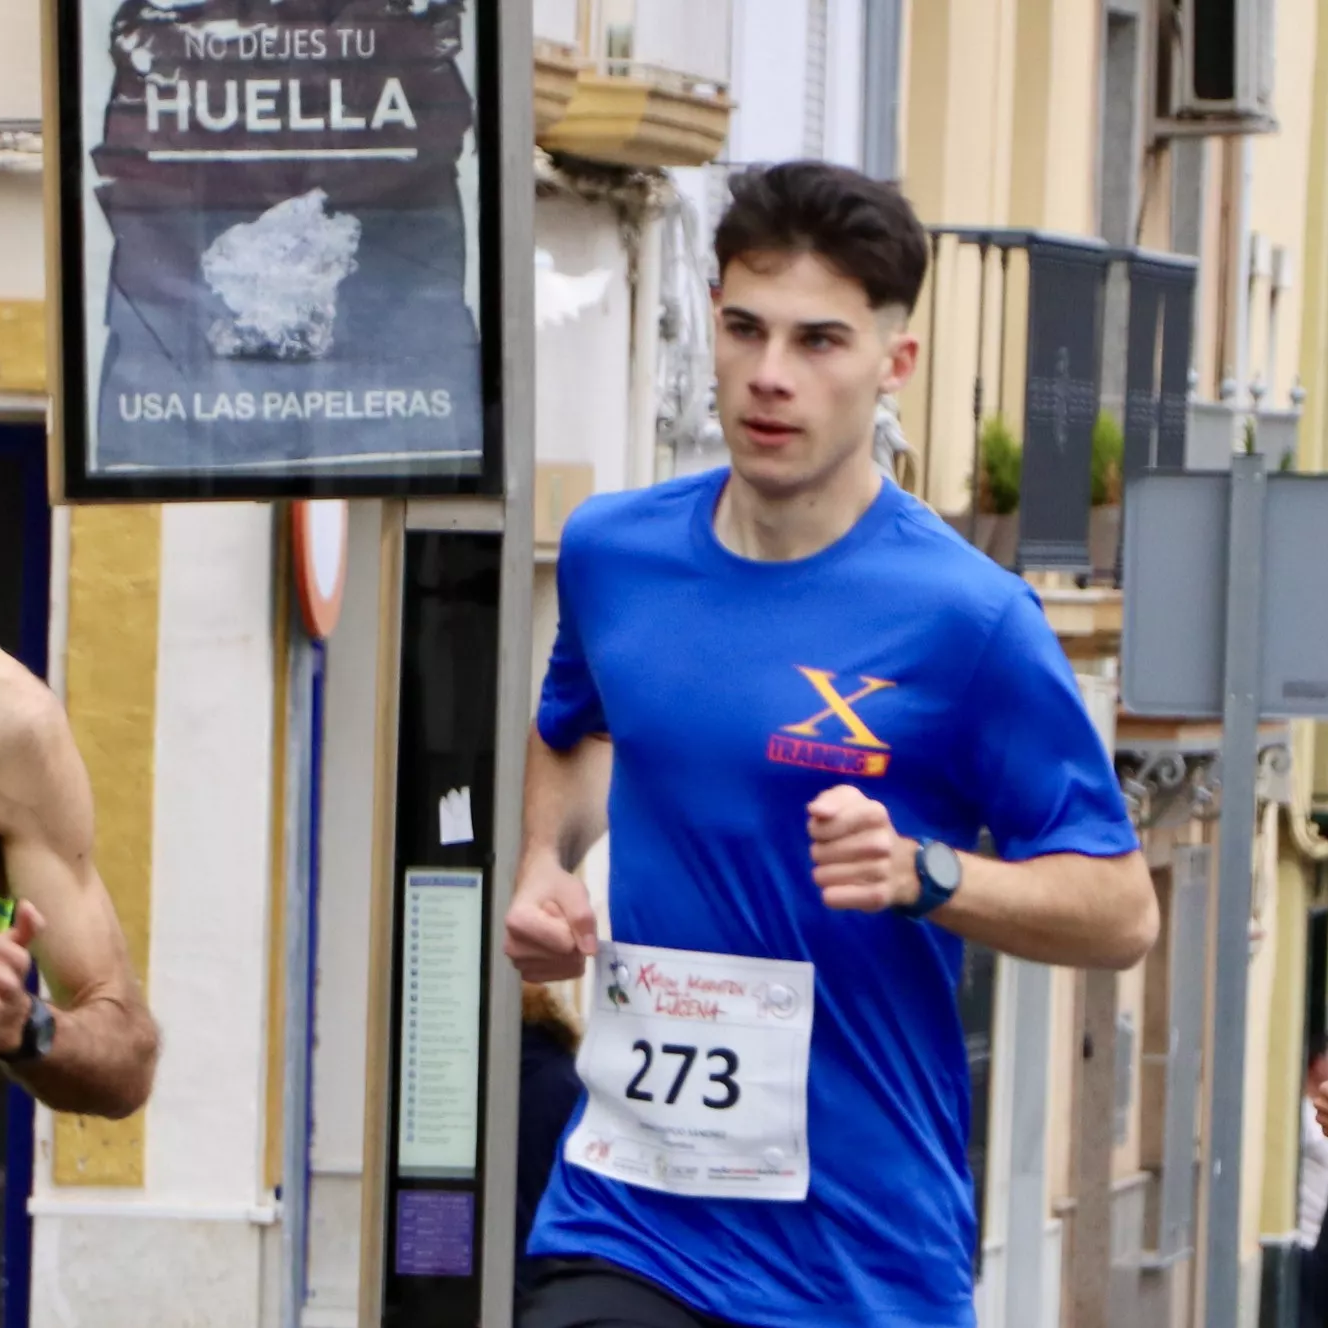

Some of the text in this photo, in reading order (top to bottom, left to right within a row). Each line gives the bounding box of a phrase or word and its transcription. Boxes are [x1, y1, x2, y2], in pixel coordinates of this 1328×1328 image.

[184, 28, 376, 60] NO DEJES TU
[145, 77, 417, 131] HUELLA
[119, 389, 452, 422] USA LAS PAPELERAS
[625, 1039, 742, 1109] 273
